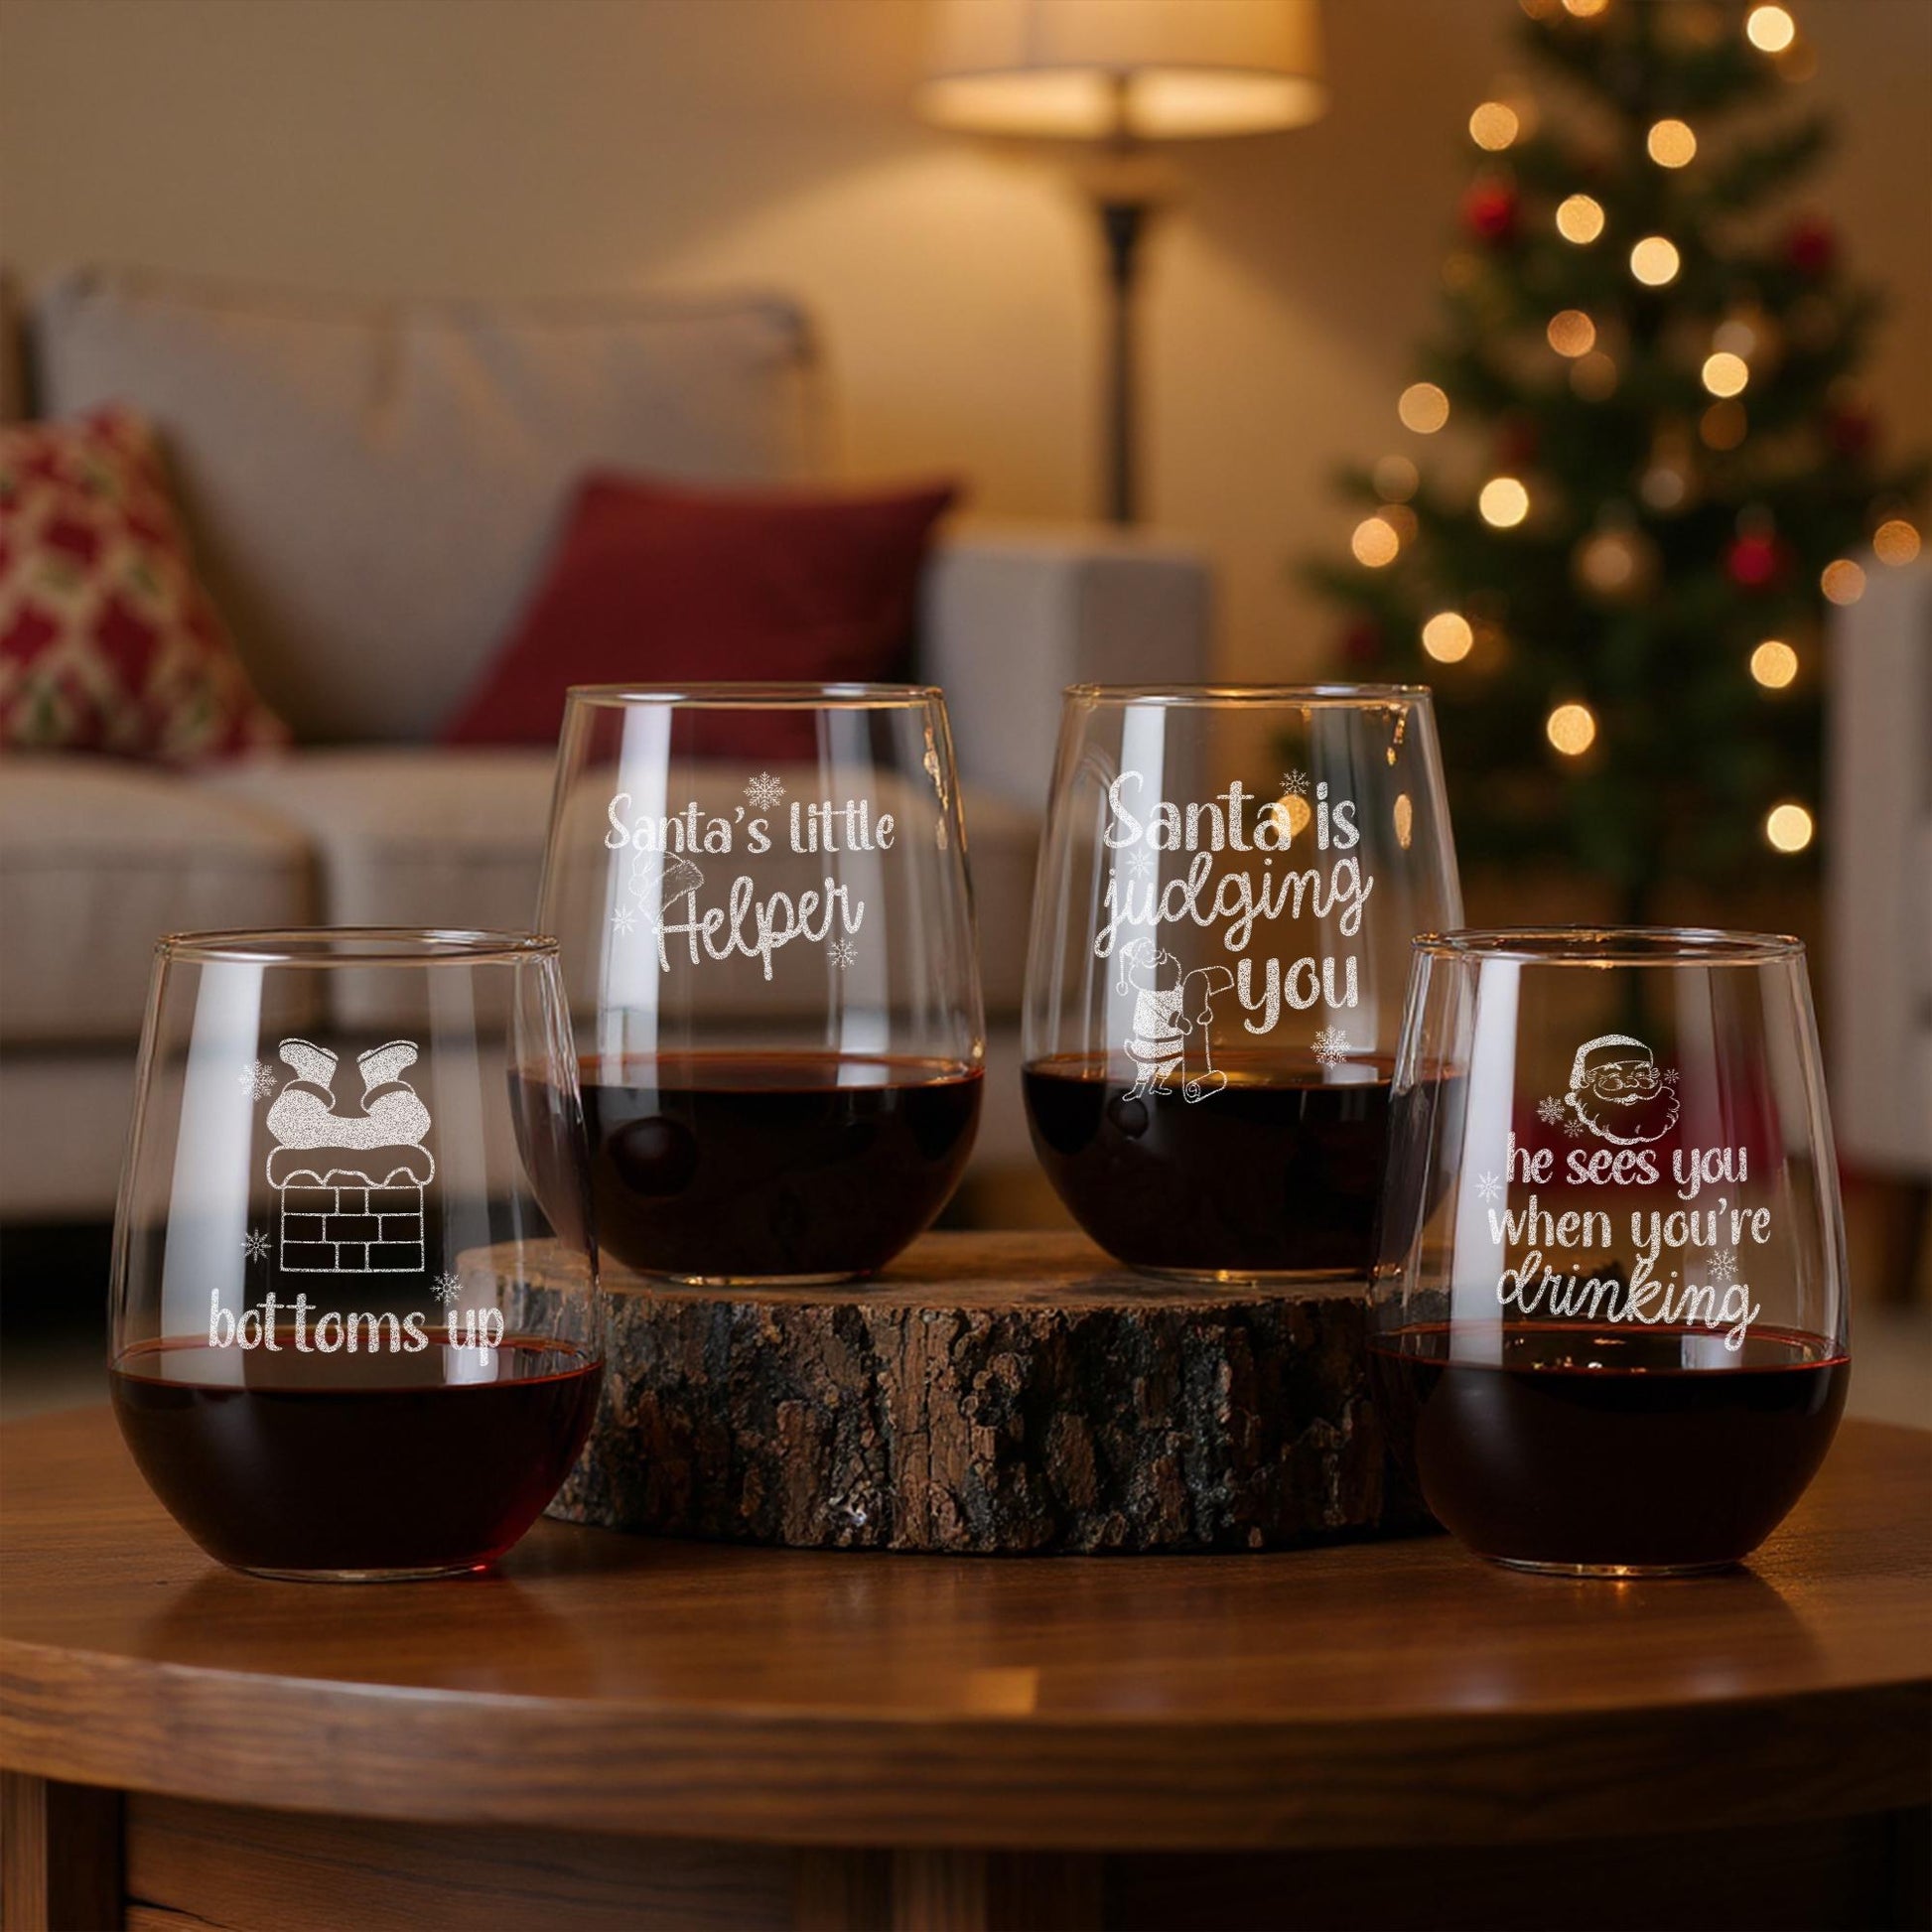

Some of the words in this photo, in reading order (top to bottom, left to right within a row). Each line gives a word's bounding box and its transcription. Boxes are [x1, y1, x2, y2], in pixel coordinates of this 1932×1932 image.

[605, 793, 771, 853] Santa's
[790, 799, 895, 853] little
[1103, 770, 1292, 851] Santa
[1315, 781, 1360, 851] is
[651, 875, 864, 981] Helper
[1093, 851, 1374, 958] judging
[1236, 955, 1358, 1035] you
[1506, 1131, 1554, 1184] he
[1566, 1149, 1660, 1185] sees
[1672, 1146, 1747, 1200] you
[1487, 1194, 1611, 1248] when
[1631, 1197, 1771, 1263] you're
[208, 1288, 429, 1353] bottoms
[447, 1308, 504, 1366] up
[1496, 1250, 1760, 1351] drinking
